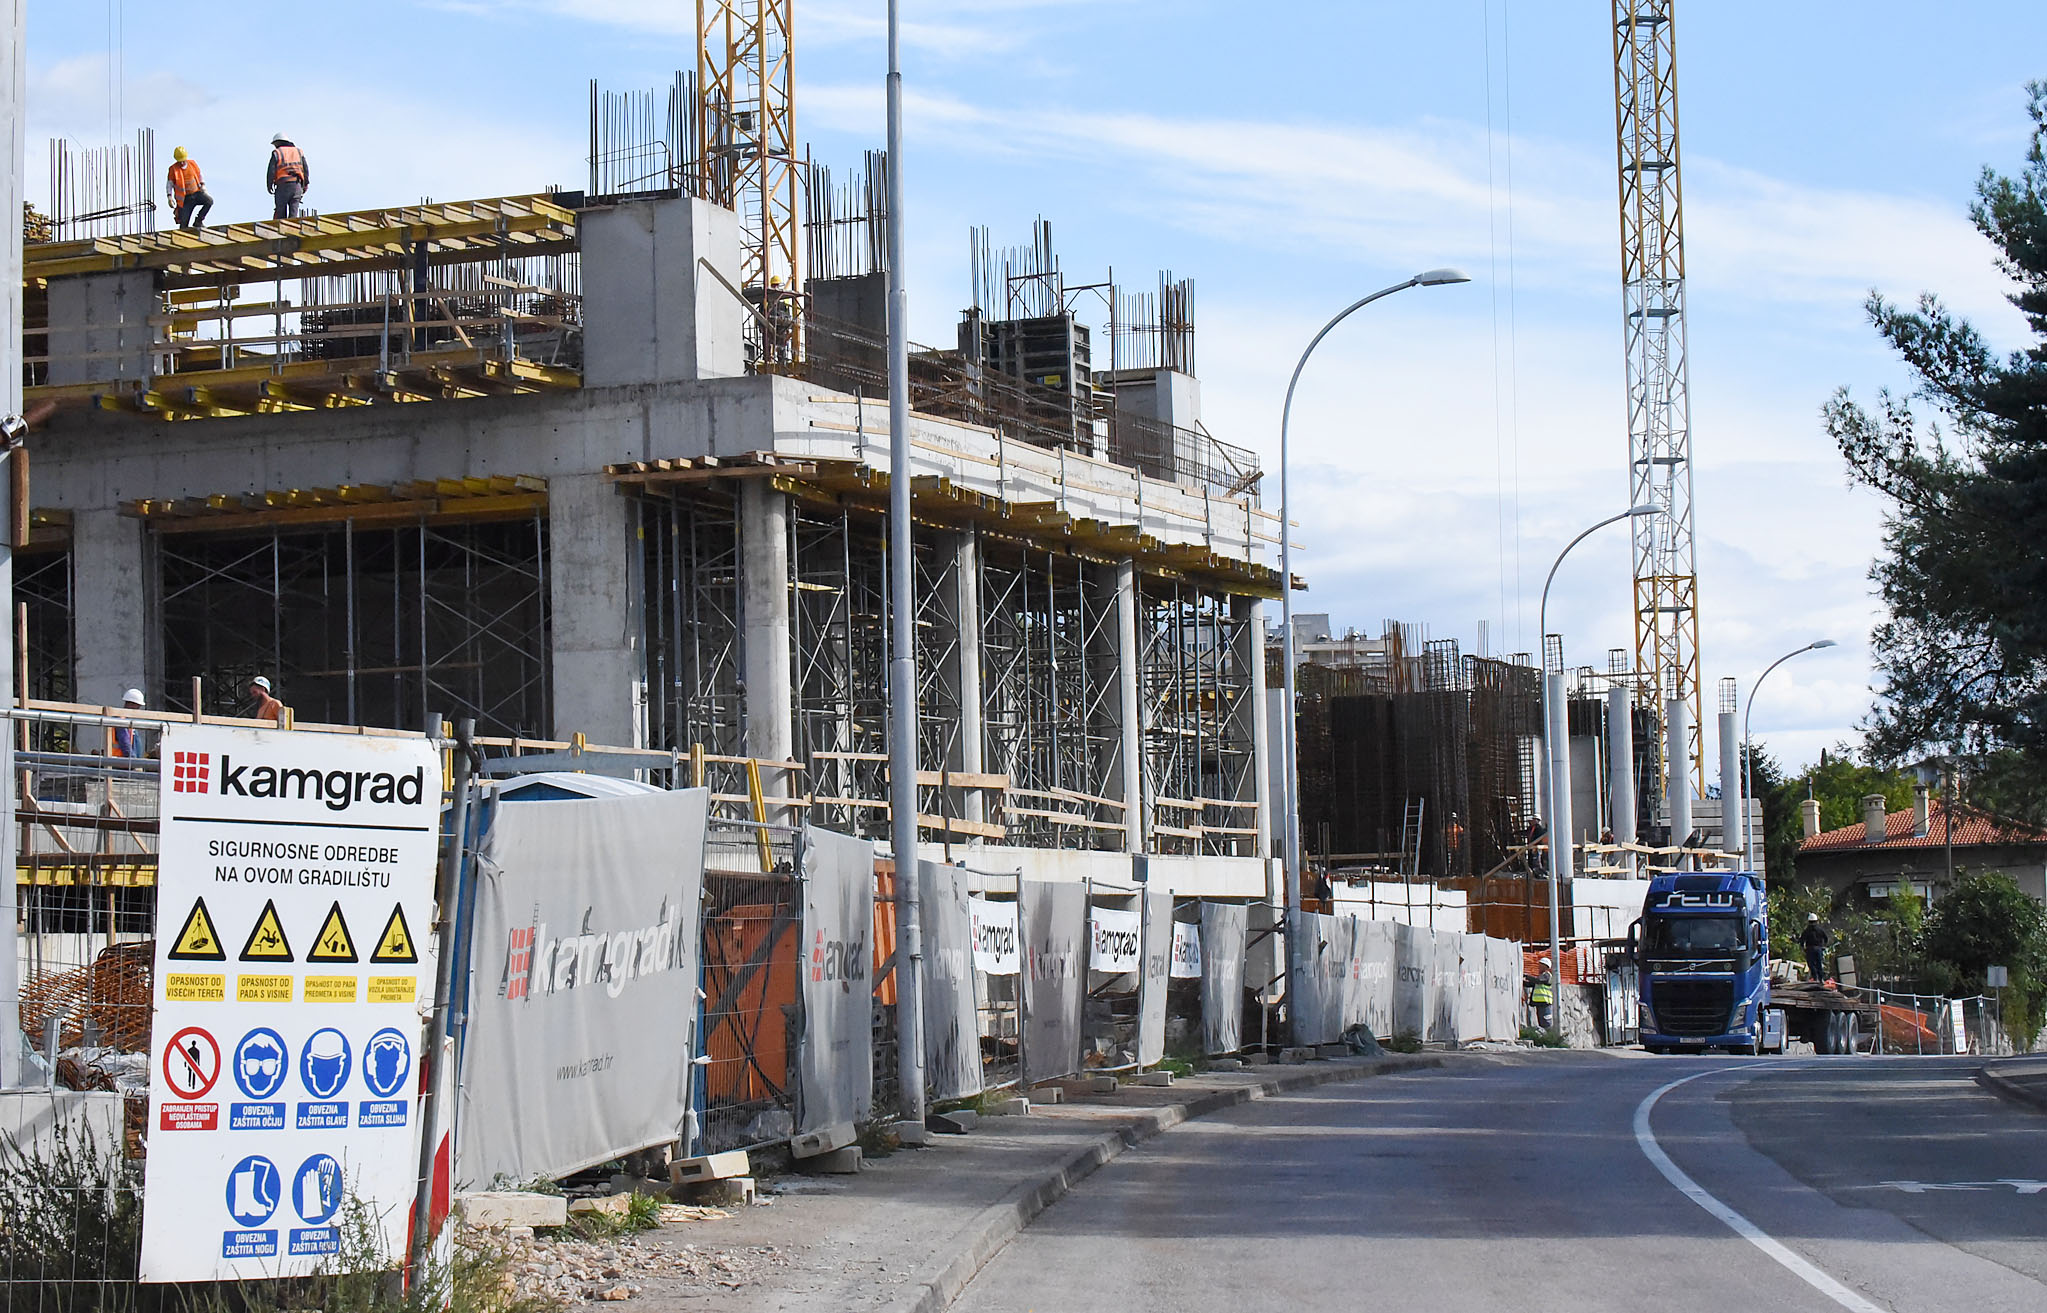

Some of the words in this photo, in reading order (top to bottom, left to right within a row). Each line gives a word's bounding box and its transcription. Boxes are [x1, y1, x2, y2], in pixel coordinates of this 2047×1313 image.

[220, 755, 424, 811] kamgrad
[208, 840, 319, 860] SIGURNOSNE
[324, 845, 399, 864] ODREDBE
[215, 866, 238, 882] NA
[244, 867, 293, 884] OVOM
[298, 866, 391, 888] GRADILIŠTU
[1099, 924, 1139, 963] amgrad
[170, 976, 209, 986] OPASNOST
[211, 977, 221, 987] OD
[241, 977, 278, 987] OPASNOST
[279, 978, 290, 987] OD
[197, 988, 224, 998] TERETA
[240, 989, 258, 998] PADA
[260, 989, 265, 998] S
[267, 990, 289, 999] VISINE
[242, 1105, 275, 1116] OBVEZNA
[308, 1104, 339, 1115] OBVEZNA
[369, 1103, 398, 1114] OBVEZNA
[232, 1115, 261, 1127] ZAŠTITA
[261, 1115, 283, 1127] OČIJU
[298, 1114, 325, 1127] ZAŠTITA
[325, 1115, 347, 1126] GLAVE
[360, 1113, 385, 1125] ZAŠTITA
[385, 1114, 406, 1125] SLUHA
[235, 1232, 267, 1244] OBVEZNA
[300, 1230, 330, 1241] OBVEZNA
[225, 1243, 254, 1256] ZAŠTITA
[255, 1243, 275, 1255] NOGU
[291, 1240, 318, 1253] ZAŠTITA
